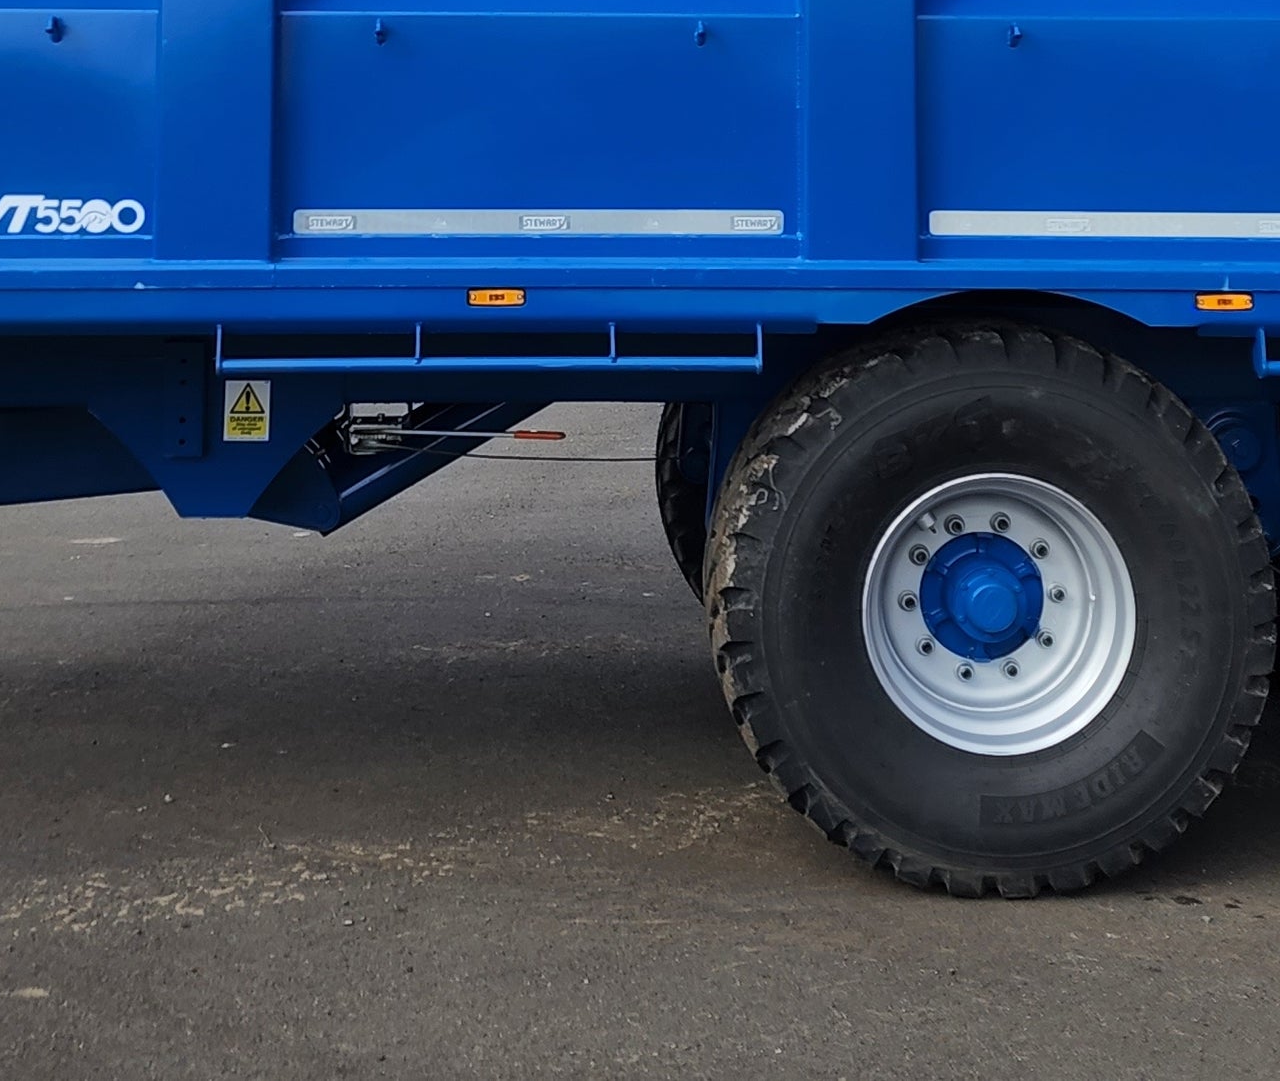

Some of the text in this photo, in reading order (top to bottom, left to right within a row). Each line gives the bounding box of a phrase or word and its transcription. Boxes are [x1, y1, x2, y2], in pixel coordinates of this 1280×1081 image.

[308, 217, 355, 230] STEWART
[521, 216, 568, 230] STEWART
[733, 216, 779, 230] STEWART
